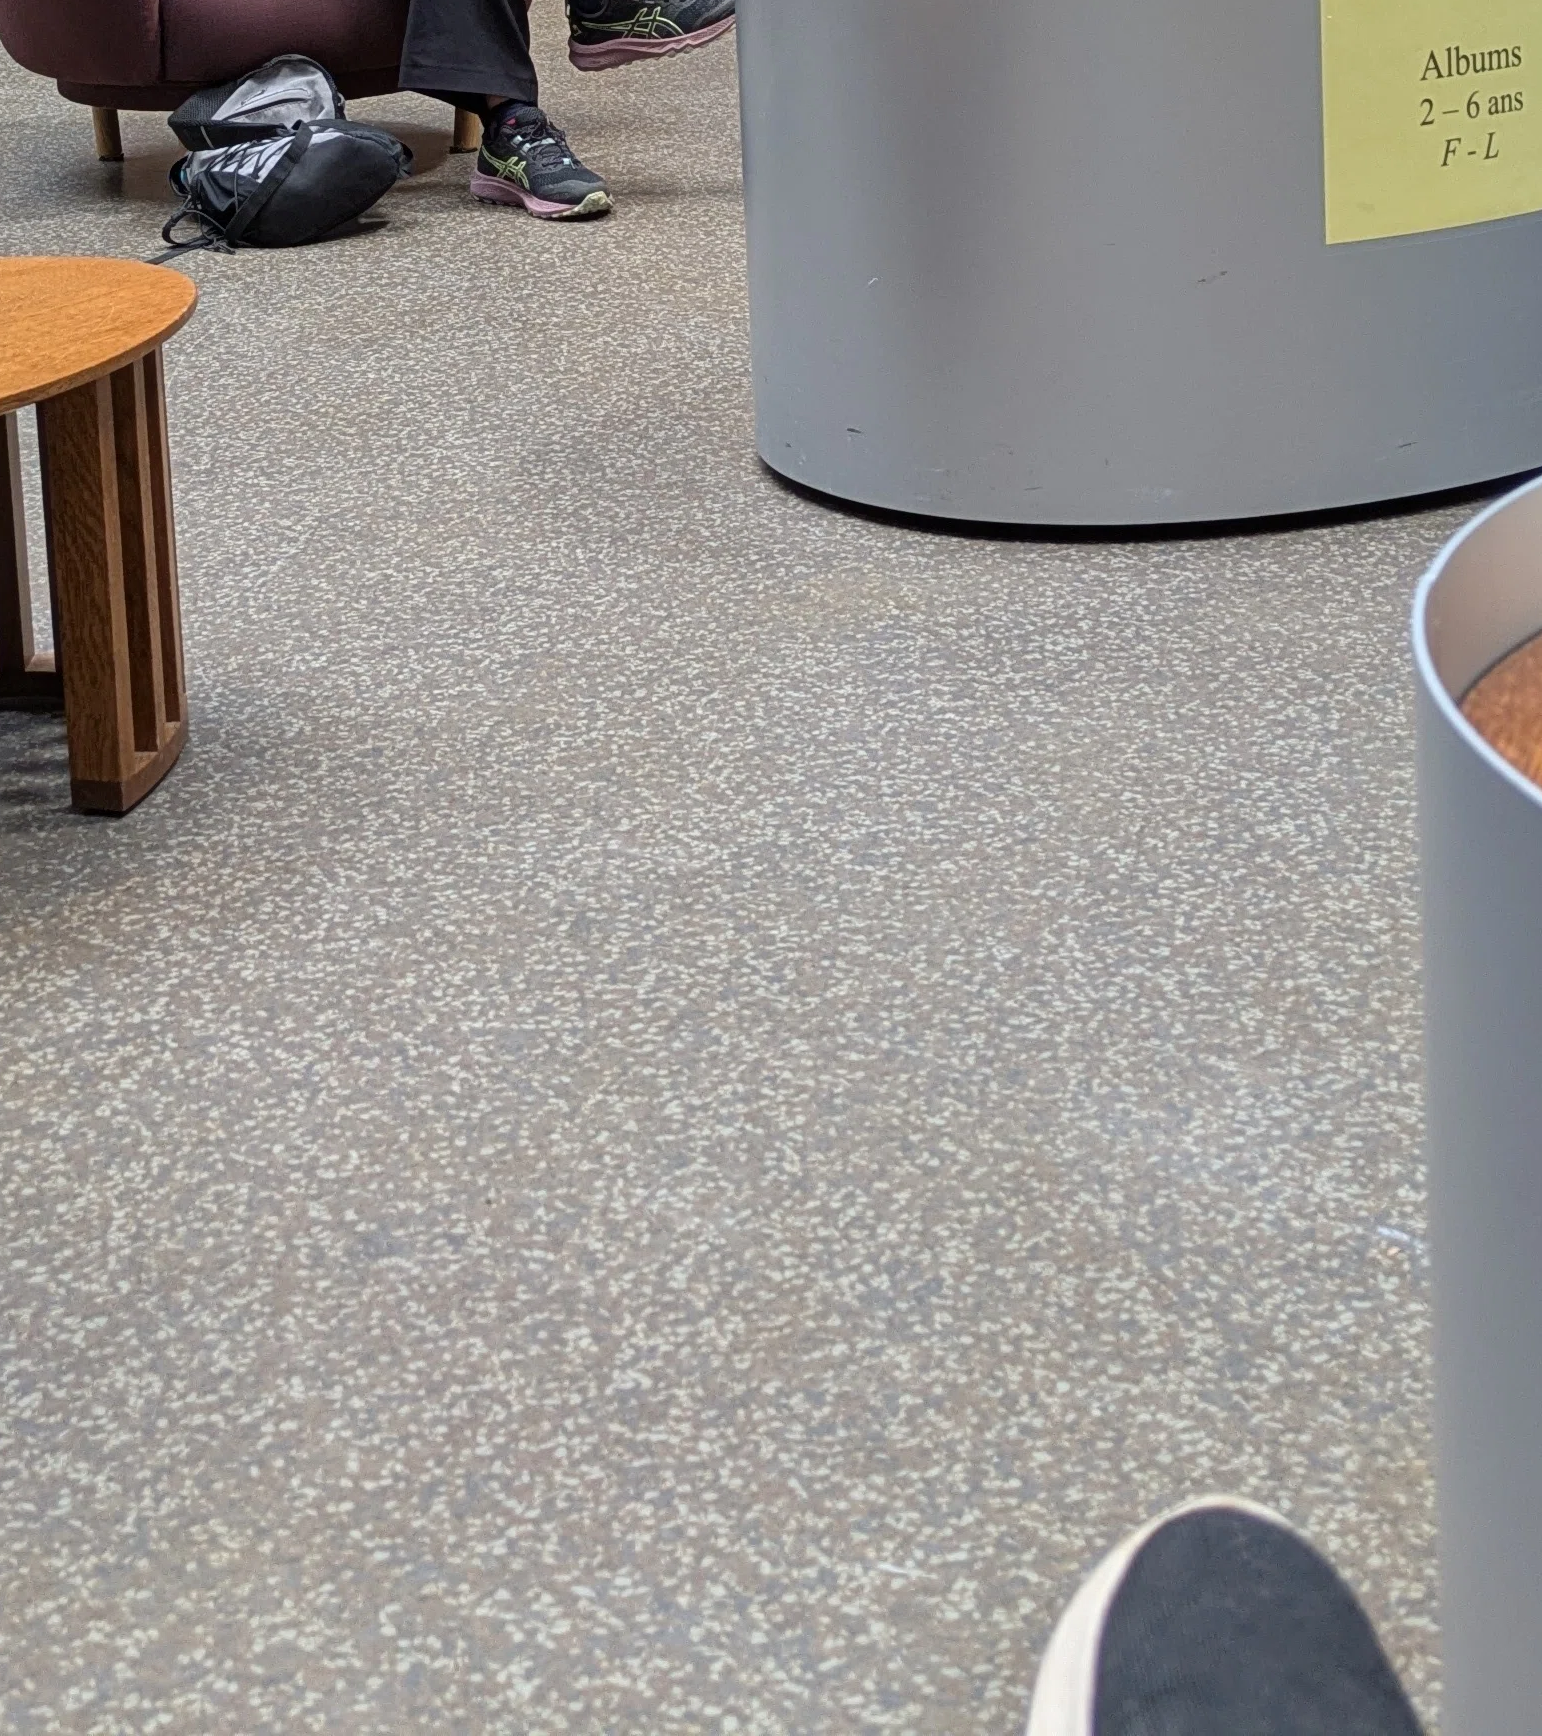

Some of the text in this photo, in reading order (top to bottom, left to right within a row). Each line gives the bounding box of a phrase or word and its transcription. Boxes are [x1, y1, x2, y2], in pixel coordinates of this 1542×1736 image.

[1420, 44, 1523, 82] Albums
[1419, 98, 1435, 127] 2
[1466, 91, 1480, 121] 6
[1487, 90, 1524, 116] ans
[1440, 138, 1462, 167] F
[1483, 132, 1500, 161] L
